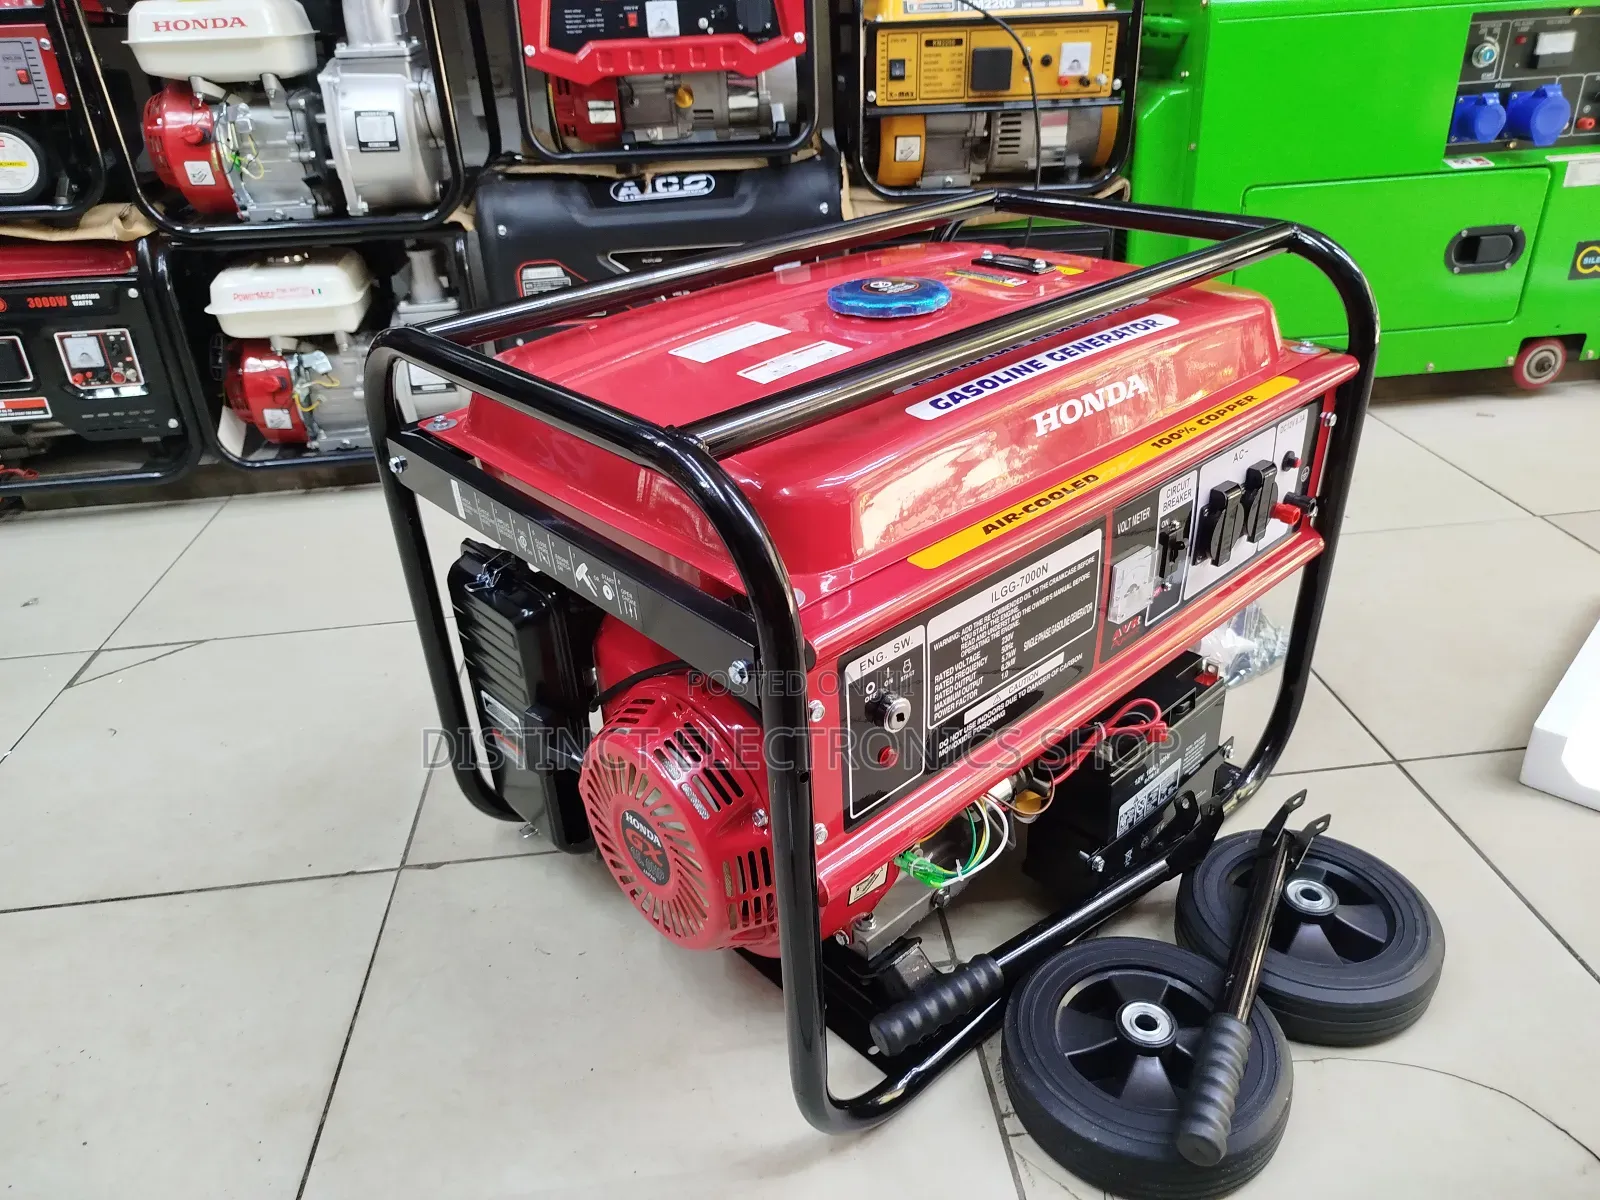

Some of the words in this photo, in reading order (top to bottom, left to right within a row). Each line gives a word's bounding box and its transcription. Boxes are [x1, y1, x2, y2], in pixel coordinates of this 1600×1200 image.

[152, 16, 247, 33] HONDA
[27, 296, 68, 308] 3000W
[72, 299, 94, 307] WATTS
[929, 359, 1048, 411] GASOLINE
[1049, 318, 1163, 363] GENERATOR
[1031, 374, 1149, 437] HONDA
[982, 473, 1100, 536] AIR-COOLED
[1151, 425, 1197, 450] 100%
[1198, 394, 1259, 427] COPPER
[1162, 487, 1192, 513] BREAKER
[1166, 476, 1191, 499] CIRCUIT
[1116, 515, 1132, 536] VOLT
[1132, 505, 1151, 527] METER
[991, 563, 1048, 603] ILGG-7000N
[933, 630, 960, 651] WARNING:
[961, 623, 972, 635] ADD
[973, 617, 983, 629] THE
[991, 595, 1023, 619] COMMENDED
[1023, 590, 1031, 601] OIL
[1032, 586, 1039, 596] TO
[1039, 581, 1048, 592] THE
[1048, 565, 1076, 586] CRANKCASE
[1077, 554, 1094, 571] BEFORE
[960, 637, 975, 650] READ
[975, 630, 986, 642] AND
[1022, 604, 1031, 616] THE
[1031, 592, 1052, 610] OWNER'S
[1053, 581, 1072, 598] MANUAL
[1072, 570, 1090, 587] BEFORE
[960, 631, 972, 643] YOU
[972, 621, 989, 636] START
[990, 616, 999, 626] THE
[1023, 634, 1037, 651] SINGLE
[1037, 625, 1051, 643] PHASE
[1051, 615, 1070, 635] GASOLINE
[1070, 601, 1092, 623] GENERATOR
[859, 649, 887, 672] ENG.
[893, 635, 913, 654] SW.
[960, 636, 989, 658] OPERATING
[990, 630, 1000, 640] THE
[883, 676, 894, 687] ON
[900, 668, 915, 683] START
[934, 665, 953, 684] RATED
[954, 650, 980, 672] VOLTAGE
[934, 675, 953, 693] RATED
[954, 655, 988, 681] FREQUENCY
[1008, 670, 1039, 694] CAUTION
[864, 691, 877, 704] OFF
[934, 684, 953, 702] RATED
[954, 670, 976, 690] OUTPUT
[934, 688, 961, 712] MAXIMUM
[961, 675, 983, 695] OUTPUT
[938, 737, 948, 749] DO
[949, 728, 962, 742] NOT
[963, 719, 976, 734] USE
[976, 702, 1004, 725] INDOORS
[1004, 693, 1017, 707] DUE
[1018, 687, 1026, 698] TO
[1026, 672, 1050, 692] DANGER
[1051, 667, 1059, 677] OF
[1059, 652, 1082, 671] CARBON
[934, 701, 954, 721] POWER
[955, 688, 977, 708] FACTOR
[938, 730, 971, 758] MONOXIDE
[972, 709, 1005, 735] POISONING
[625, 811, 662, 849] HONDA
